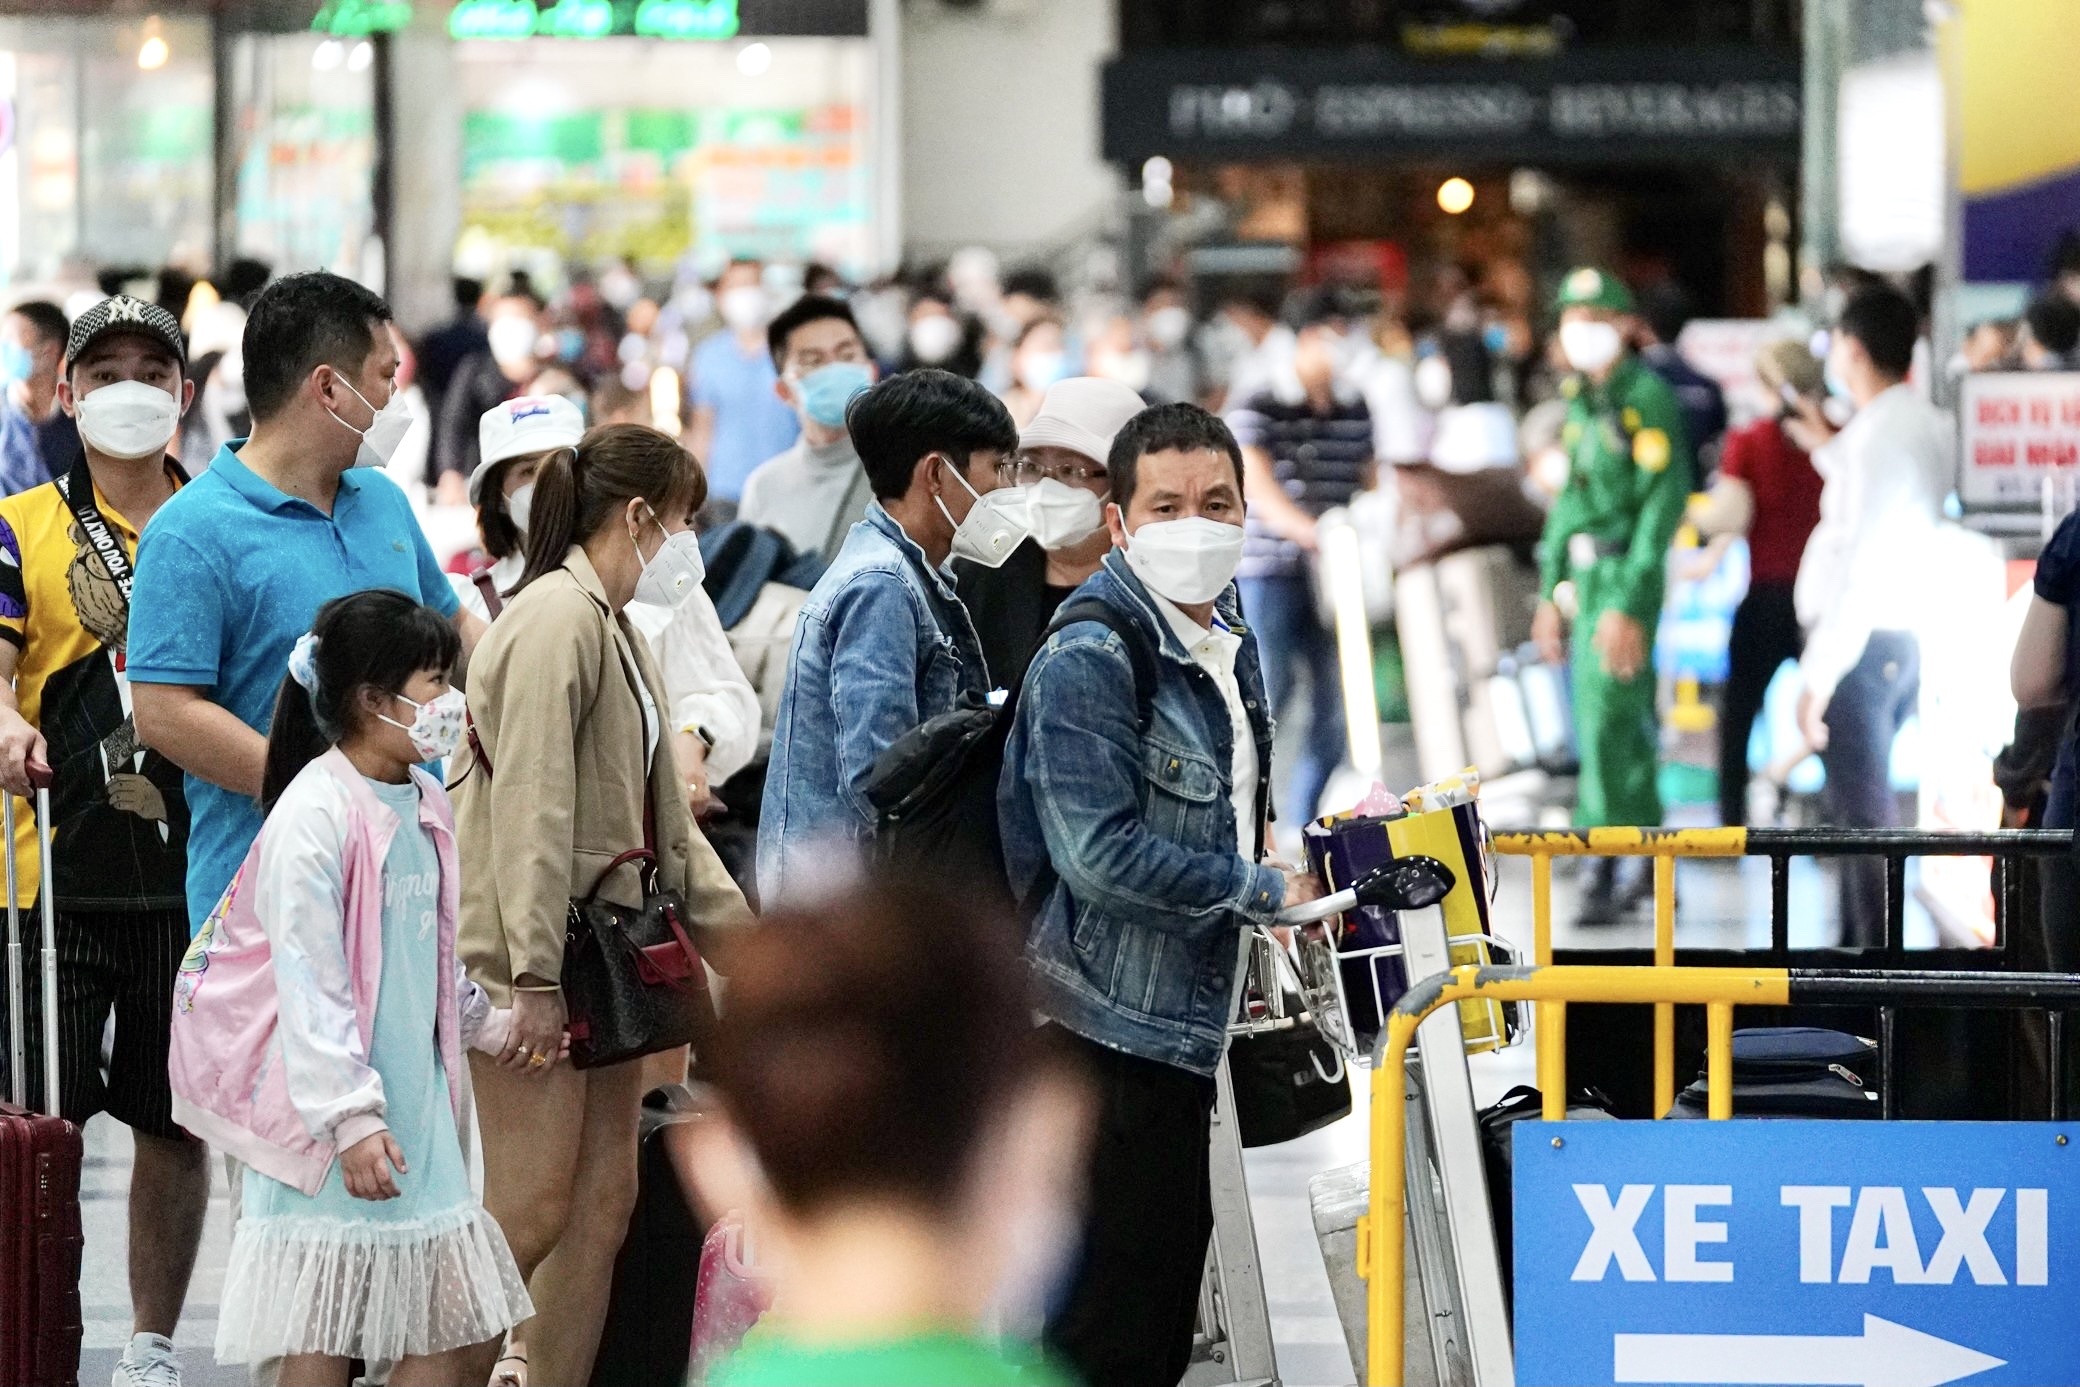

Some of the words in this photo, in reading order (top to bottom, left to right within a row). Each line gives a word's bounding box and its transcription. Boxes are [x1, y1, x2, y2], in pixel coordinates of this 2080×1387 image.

[84, 520, 115, 551] ONLY
[101, 550, 129, 576] YOU
[1570, 1184, 1734, 1283] XE
[1780, 1185, 2049, 1287] TAXI
